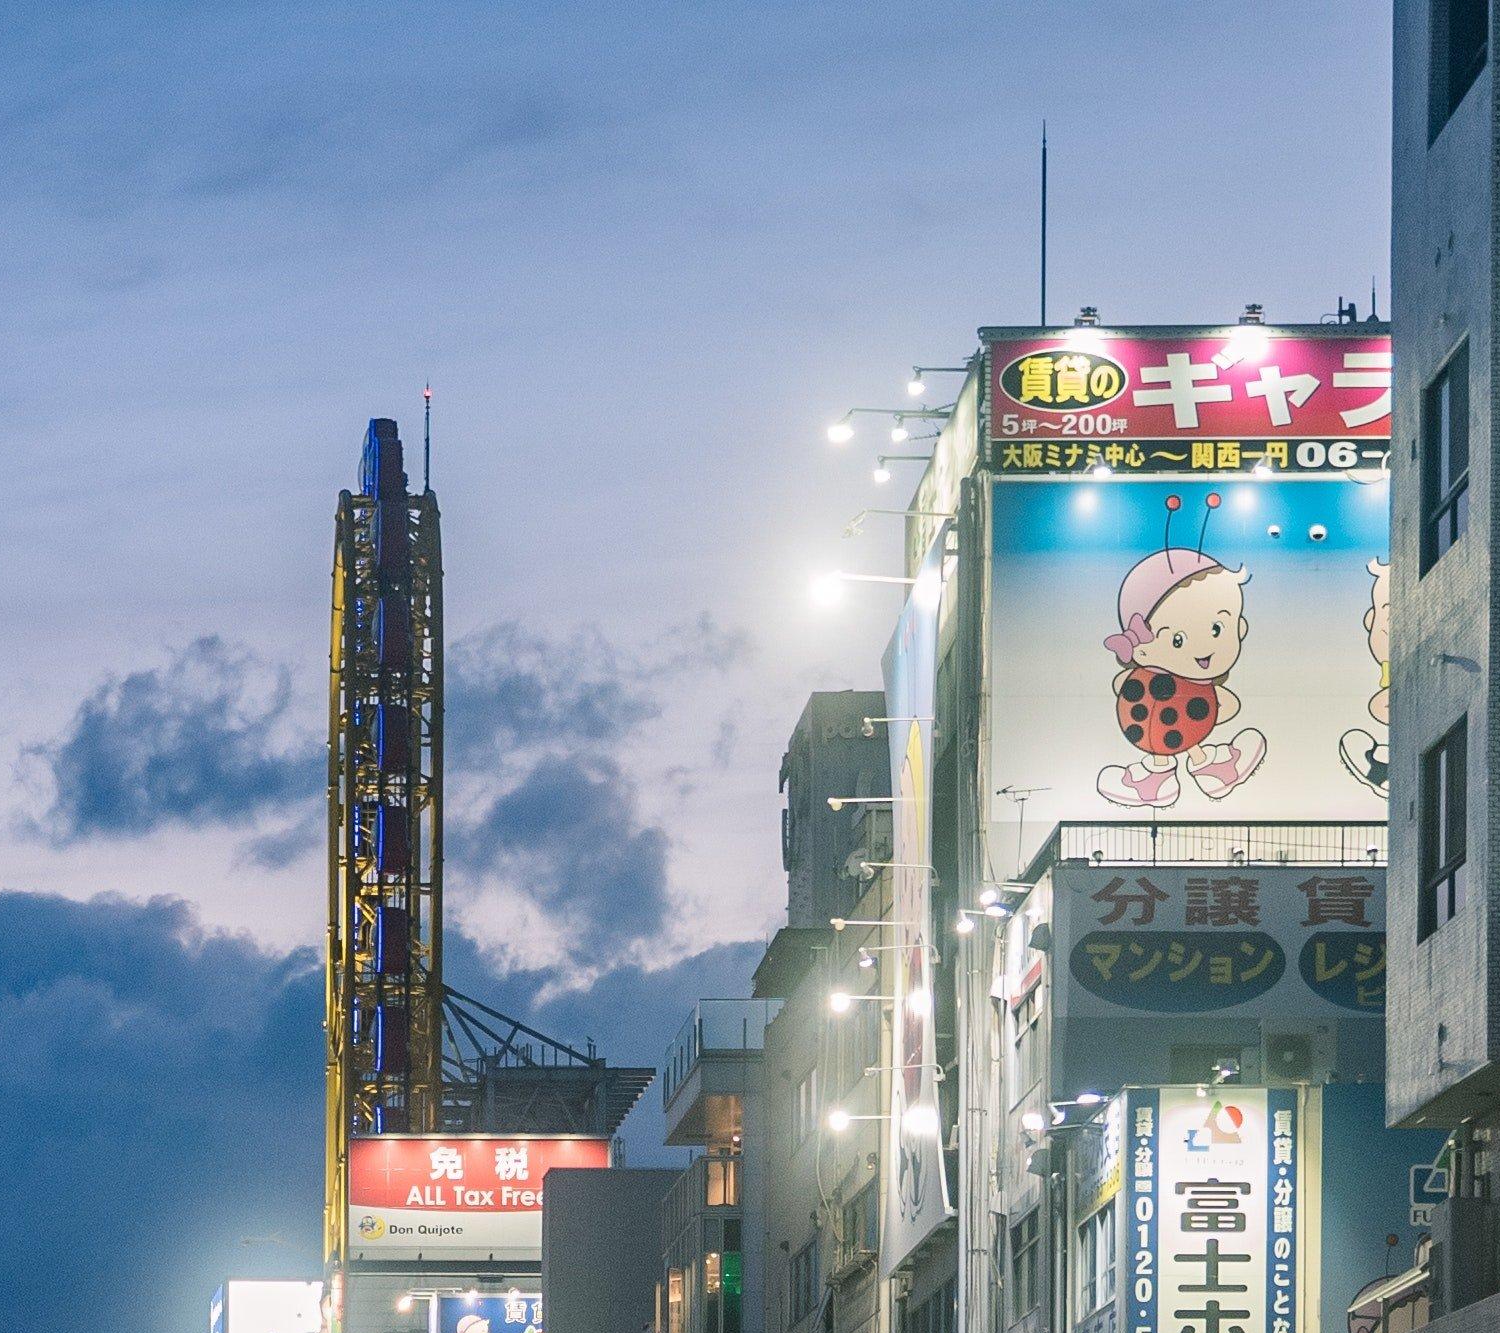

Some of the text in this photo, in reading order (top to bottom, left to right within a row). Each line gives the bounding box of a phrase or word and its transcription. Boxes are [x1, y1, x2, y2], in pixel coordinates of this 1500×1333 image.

[1018, 356, 1120, 404] 賃貸の
[1296, 440, 1391, 470] 06-
[1091, 875, 1261, 927] 分譲
[1084, 941, 1274, 984] マンション
[429, 1146, 528, 1181] 免税
[406, 1186, 446, 1207] ALL
[453, 1186, 495, 1208] Tax
[389, 1223, 464, 1238] Don Quijote
